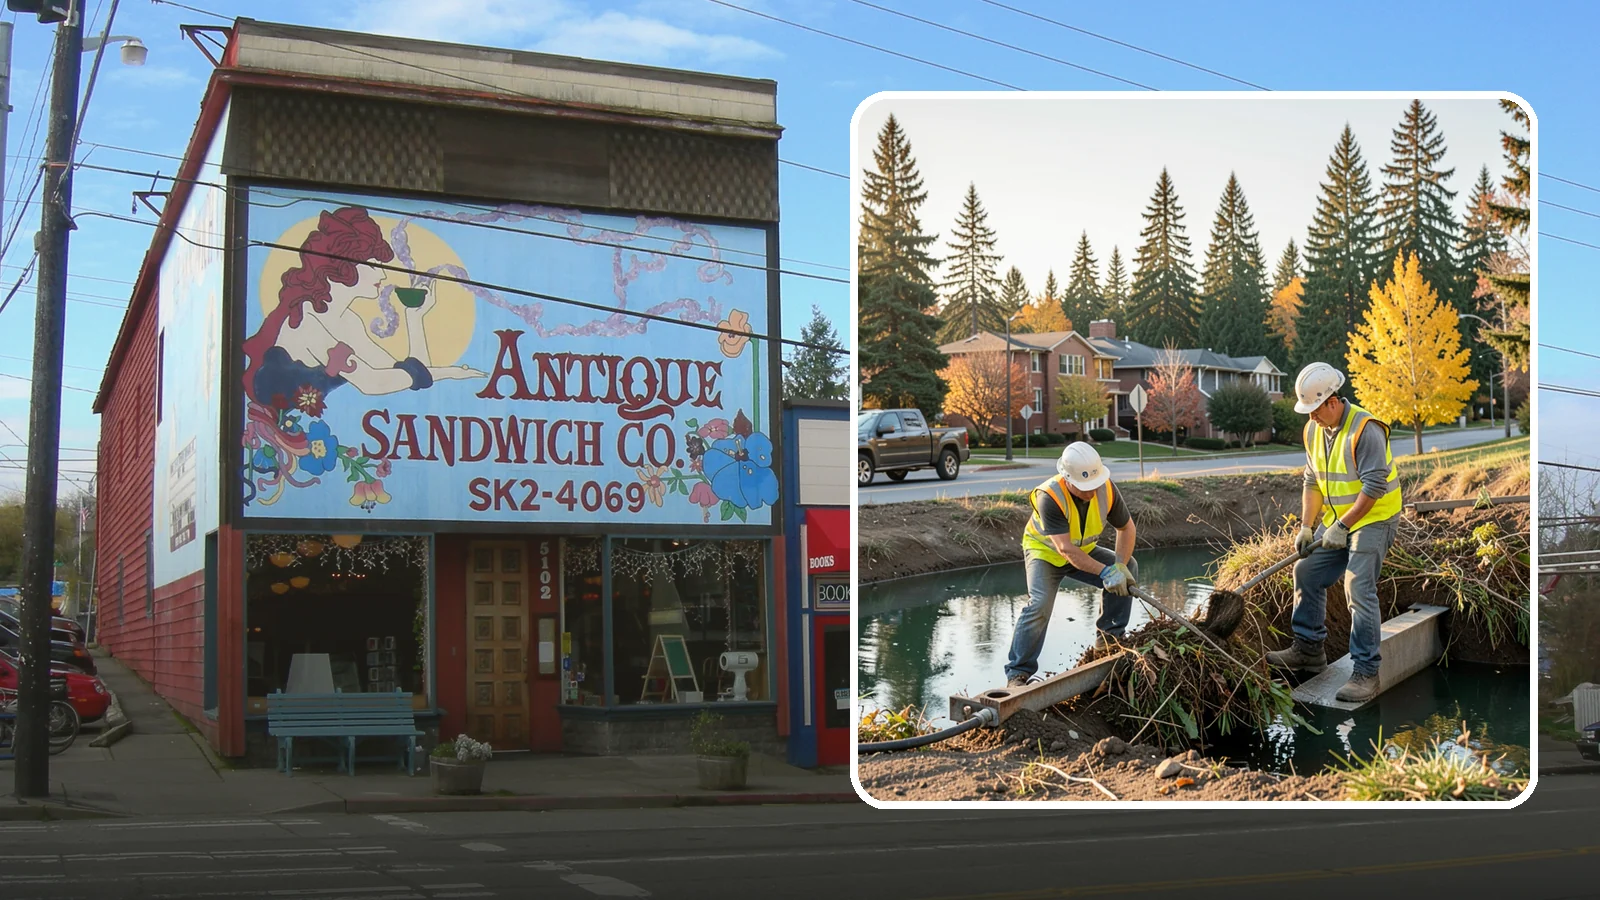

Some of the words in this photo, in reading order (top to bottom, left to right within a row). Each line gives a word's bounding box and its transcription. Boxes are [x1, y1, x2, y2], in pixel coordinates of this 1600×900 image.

[476, 329, 723, 420] ANTIQUE
[361, 408, 605, 467] SANDWICH
[617, 422, 685, 468] CO.
[468, 477, 645, 513] SK2-4069
[809, 555, 835, 569] BOOKS
